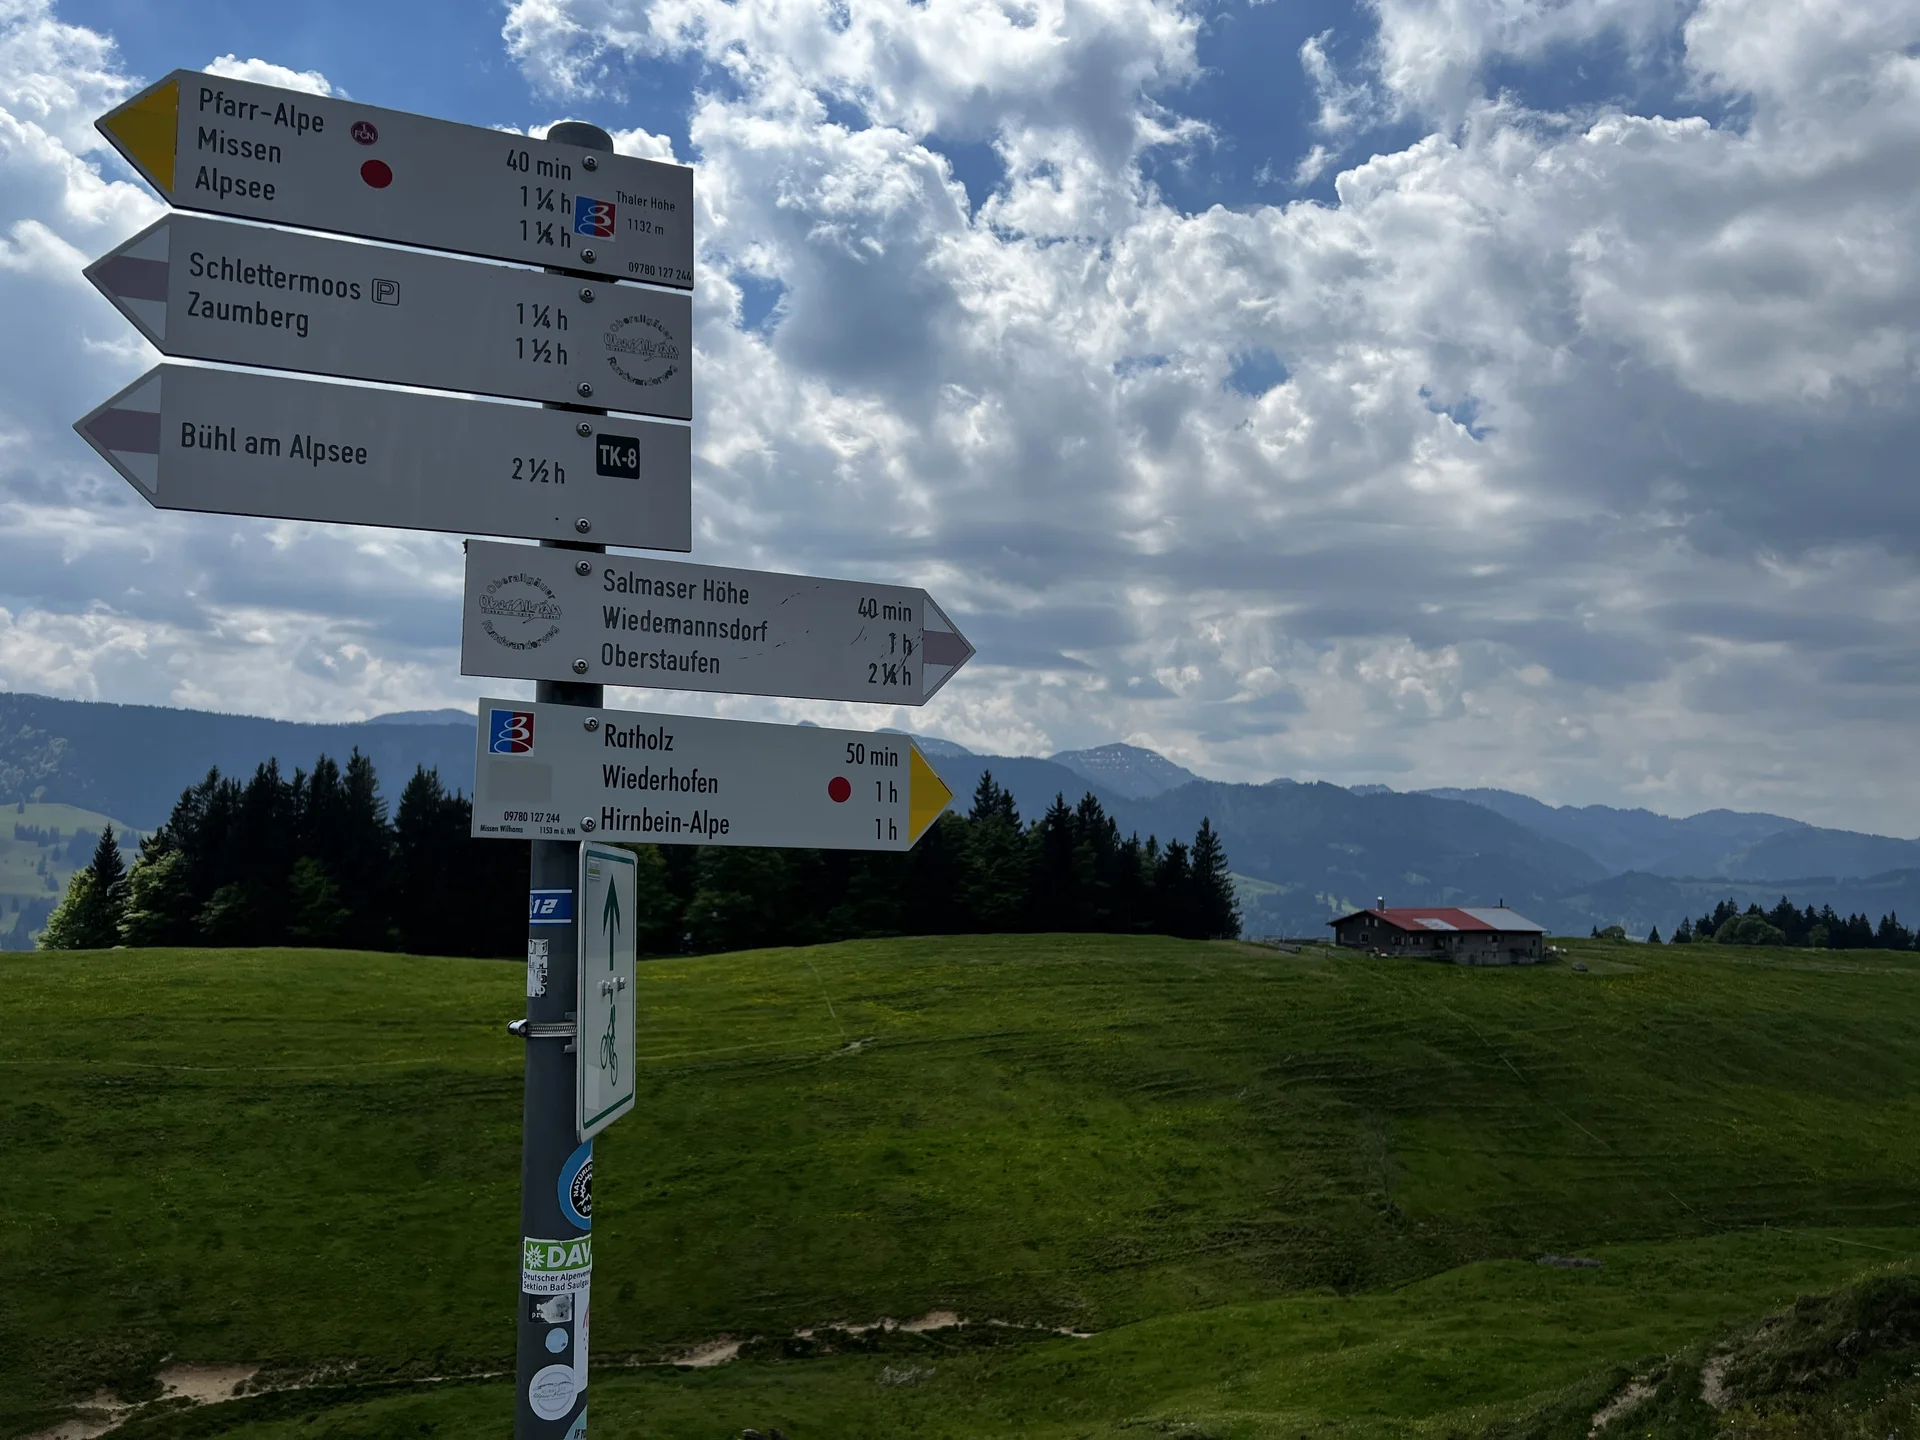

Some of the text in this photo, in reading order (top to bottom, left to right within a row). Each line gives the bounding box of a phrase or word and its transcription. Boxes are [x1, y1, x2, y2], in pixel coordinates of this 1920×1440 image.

[199, 87, 325, 136] Pfarr-Alpe
[197, 126, 282, 164] Missen
[506, 148, 571, 181] 40 min
[195, 165, 276, 200] Alpsee
[560, 192, 571, 215] h
[615, 190, 648, 207] Thaler
[560, 225, 571, 249] h
[627, 218, 664, 235] 1132 m
[189, 251, 362, 301] Schlettermoos
[628, 261, 692, 281] 09780 127 244
[187, 290, 309, 339] Zaumberg
[557, 308, 568, 331] h
[557, 343, 568, 365] h
[180, 421, 369, 468] Bühl am Alpsee
[599, 444, 638, 469] TK-8
[554, 462, 565, 485] h
[603, 568, 750, 605] Salmaser Höhe
[857, 597, 912, 622] 40 min
[602, 605, 768, 643] Wiedemannsdorf
[902, 633, 913, 656] h
[601, 642, 721, 675] Oberstaufen
[902, 666, 912, 687] h
[604, 723, 675, 752] Ratholz
[845, 742, 899, 768] 50 min
[602, 763, 719, 795] Wiederhofen
[875, 780, 898, 804] 1 h
[480, 824, 499, 833] Missen
[539, 826, 553, 835] 1153
[503, 811, 560, 824] 09780 127 244
[600, 805, 730, 840] Hirnbein-Alpe
[875, 817, 898, 841] 1 h
[546, 1242, 591, 1268] DAV
[523, 1271, 559, 1282] Deutscher
[523, 1281, 548, 1291] Sektion
[550, 1283, 566, 1292] Bad
